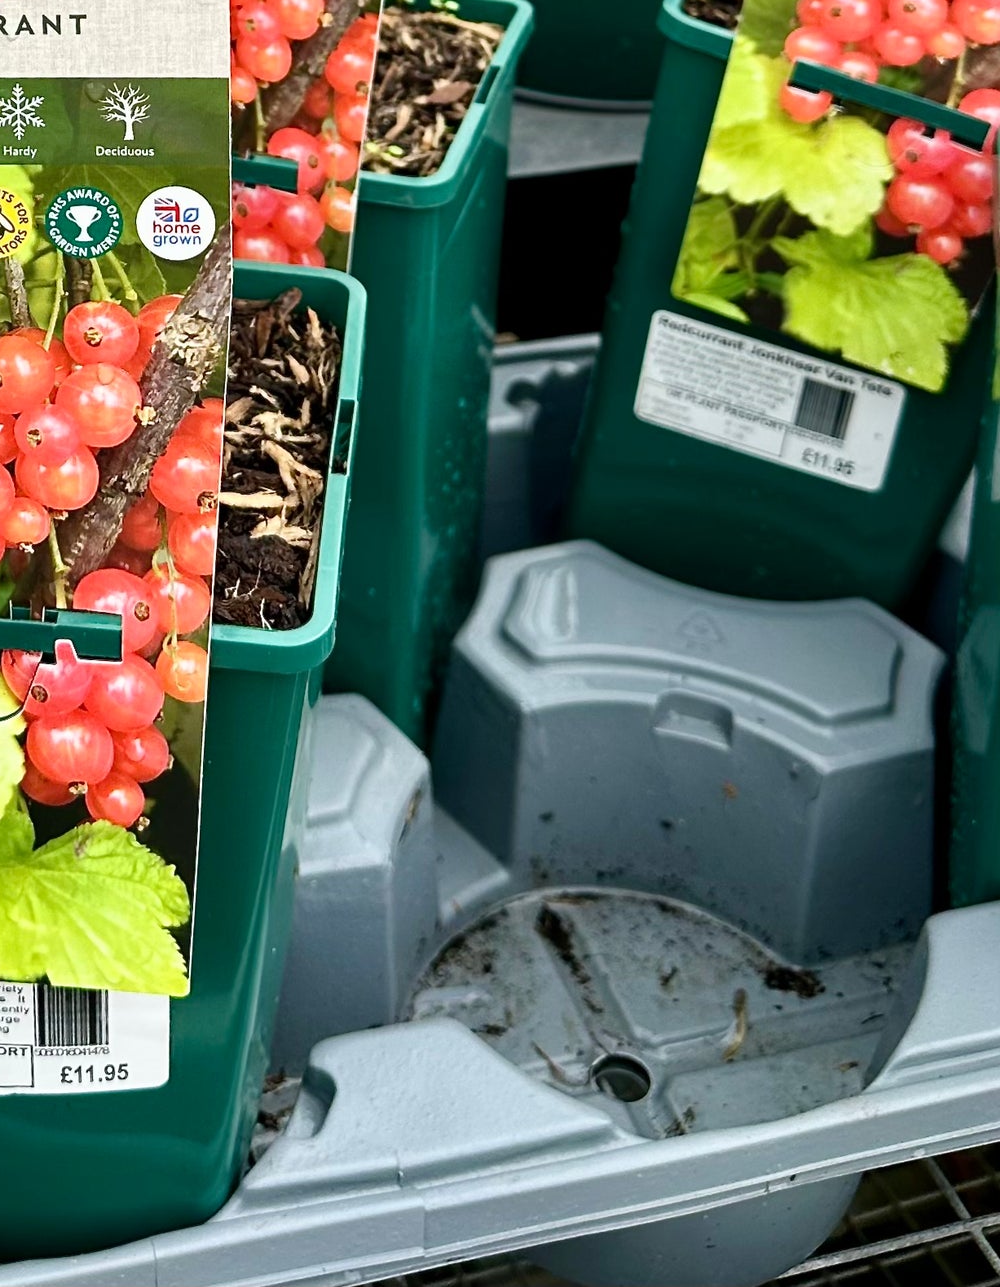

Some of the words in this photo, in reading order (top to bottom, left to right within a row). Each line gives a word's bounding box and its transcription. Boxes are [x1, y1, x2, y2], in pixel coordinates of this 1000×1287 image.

[3, 146, 37, 158] Hardy
[95, 145, 155, 156] Deciduous
[49, 197, 66, 219] RHS
[66, 188, 109, 206] AWARD
[106, 205, 120, 220] OF
[14, 202, 29, 225] FOR
[153, 220, 201, 234] home
[49, 227, 88, 257] GARDEN
[90, 226, 120, 256] MERIT
[153, 235, 201, 247] grown
[60, 1063, 129, 1083] £11.95
